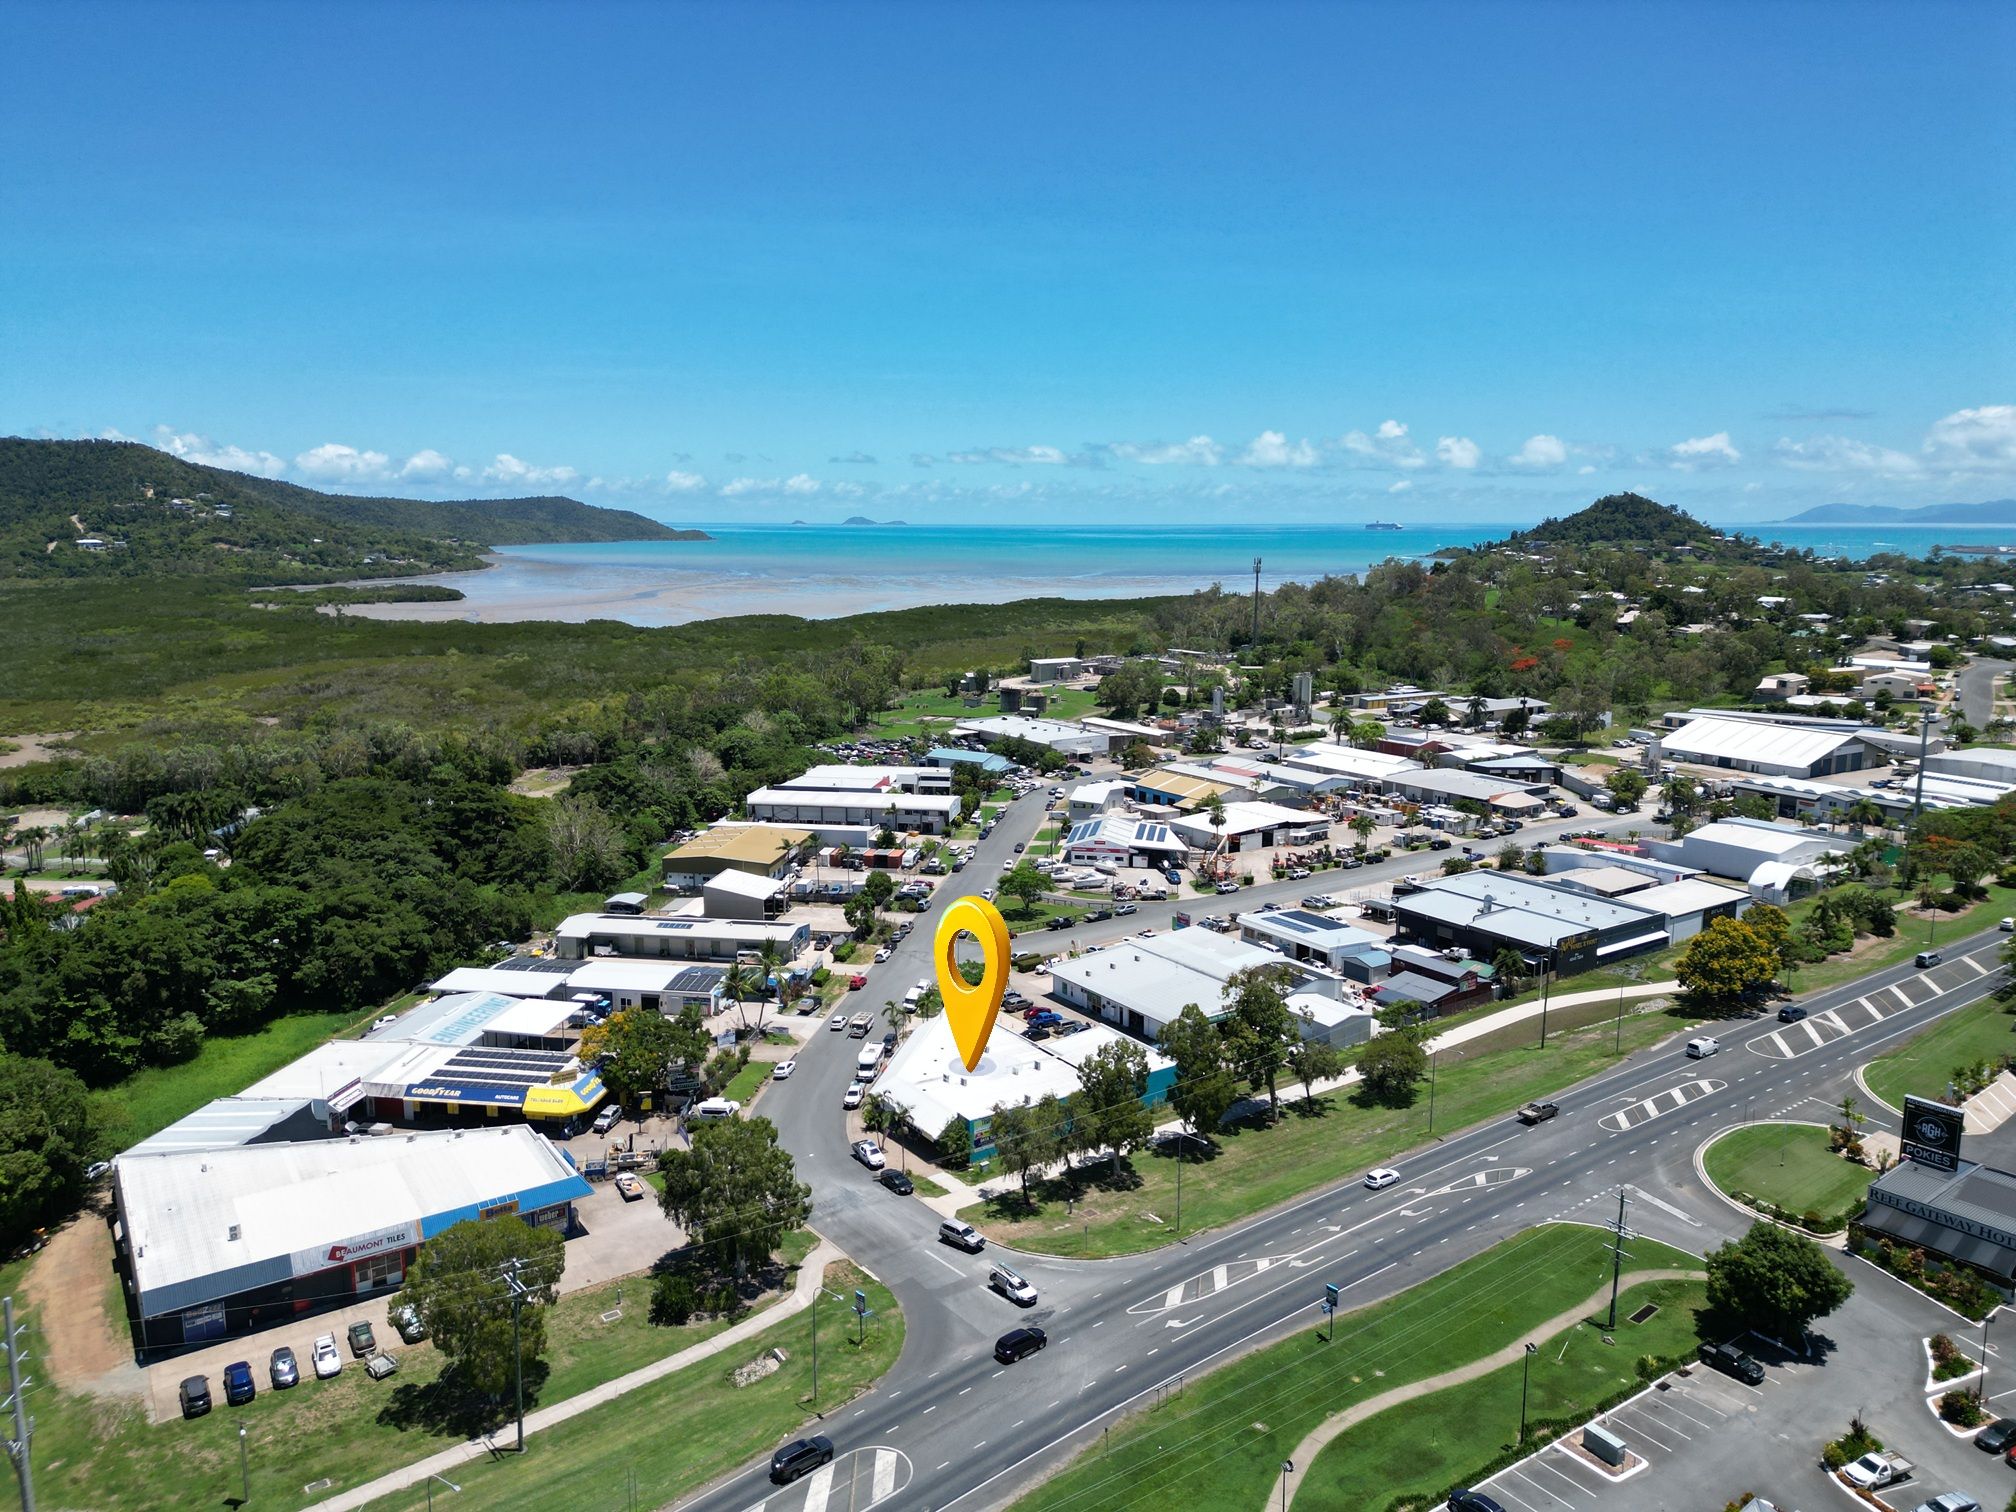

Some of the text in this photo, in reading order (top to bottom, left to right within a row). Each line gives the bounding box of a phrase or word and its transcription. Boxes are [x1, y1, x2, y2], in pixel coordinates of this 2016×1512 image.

[430, 997, 512, 1043] ENGINEERING
[411, 1086, 462, 1097] GOODYEAR
[1906, 1145, 1951, 1166] POKIES
[1870, 1188, 1902, 1208] REEF
[1905, 1201, 1976, 1233] GATEWAY
[335, 1233, 406, 1258] BEAUMONT TILES
